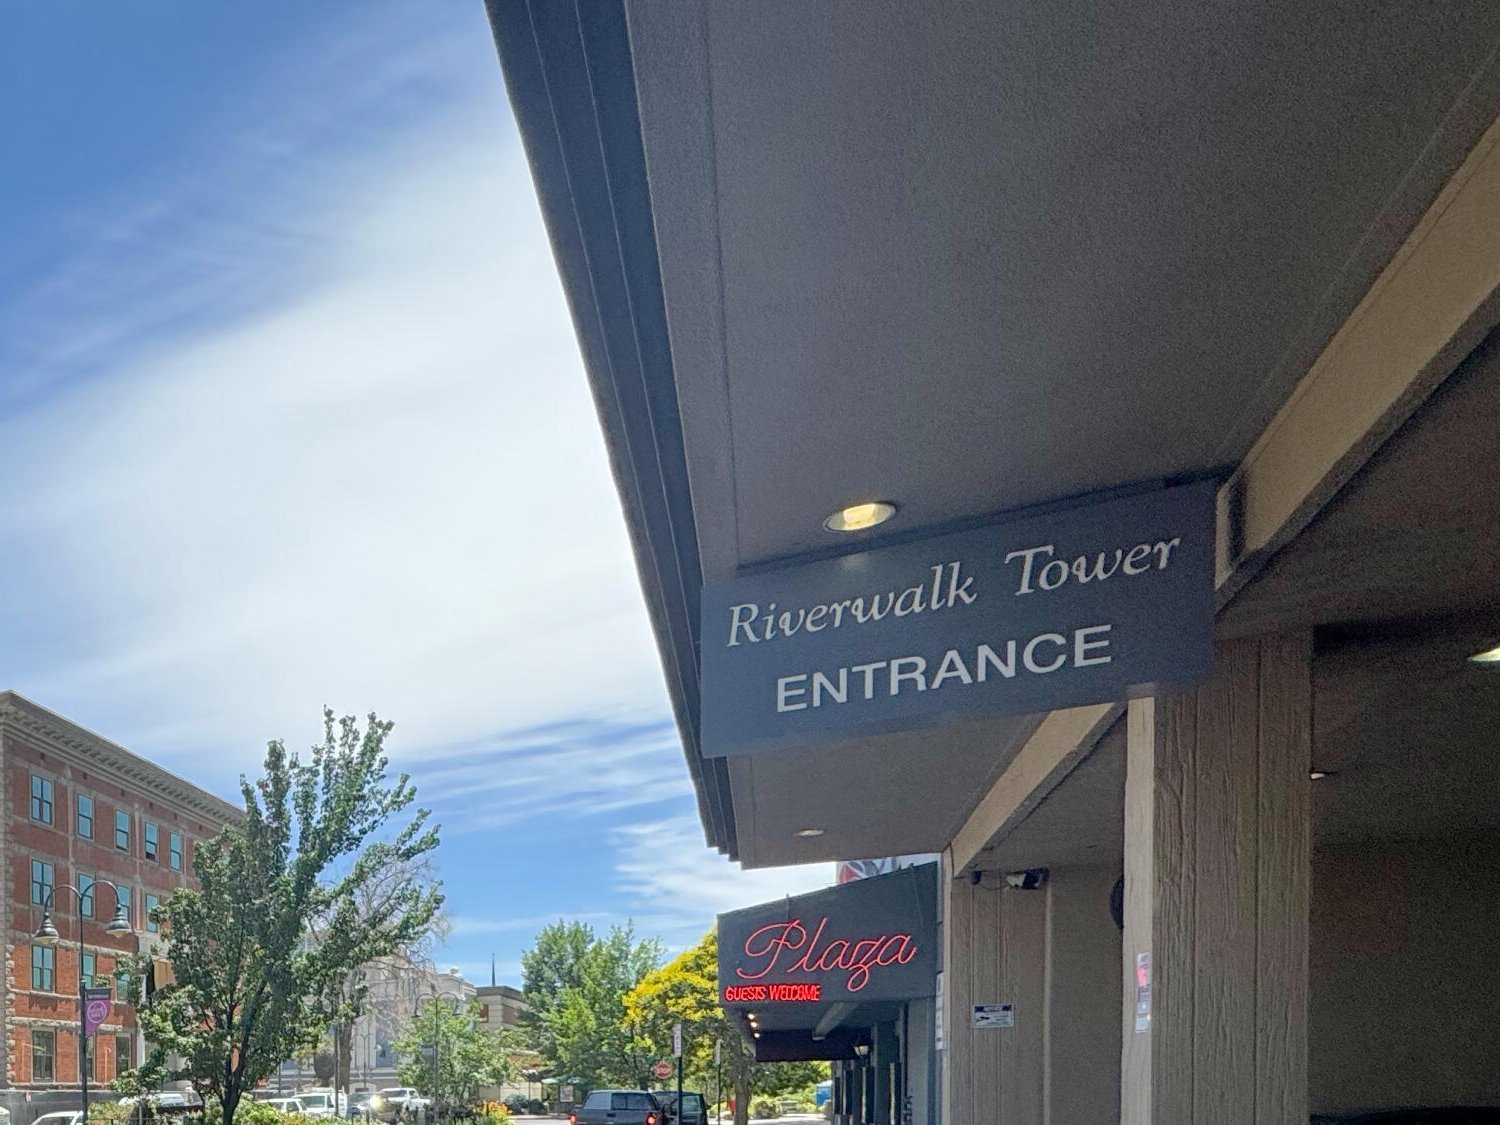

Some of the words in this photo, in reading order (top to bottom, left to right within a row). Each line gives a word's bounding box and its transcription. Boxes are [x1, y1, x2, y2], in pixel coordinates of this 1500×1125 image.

[727, 561, 978, 648] Riverwalk
[1004, 536, 1181, 597] Tower
[776, 624, 1113, 713] ENTRANCE
[725, 984, 767, 1002] GUESTS
[767, 983, 821, 1002] WELCOME
[736, 917, 918, 993] Plaza
